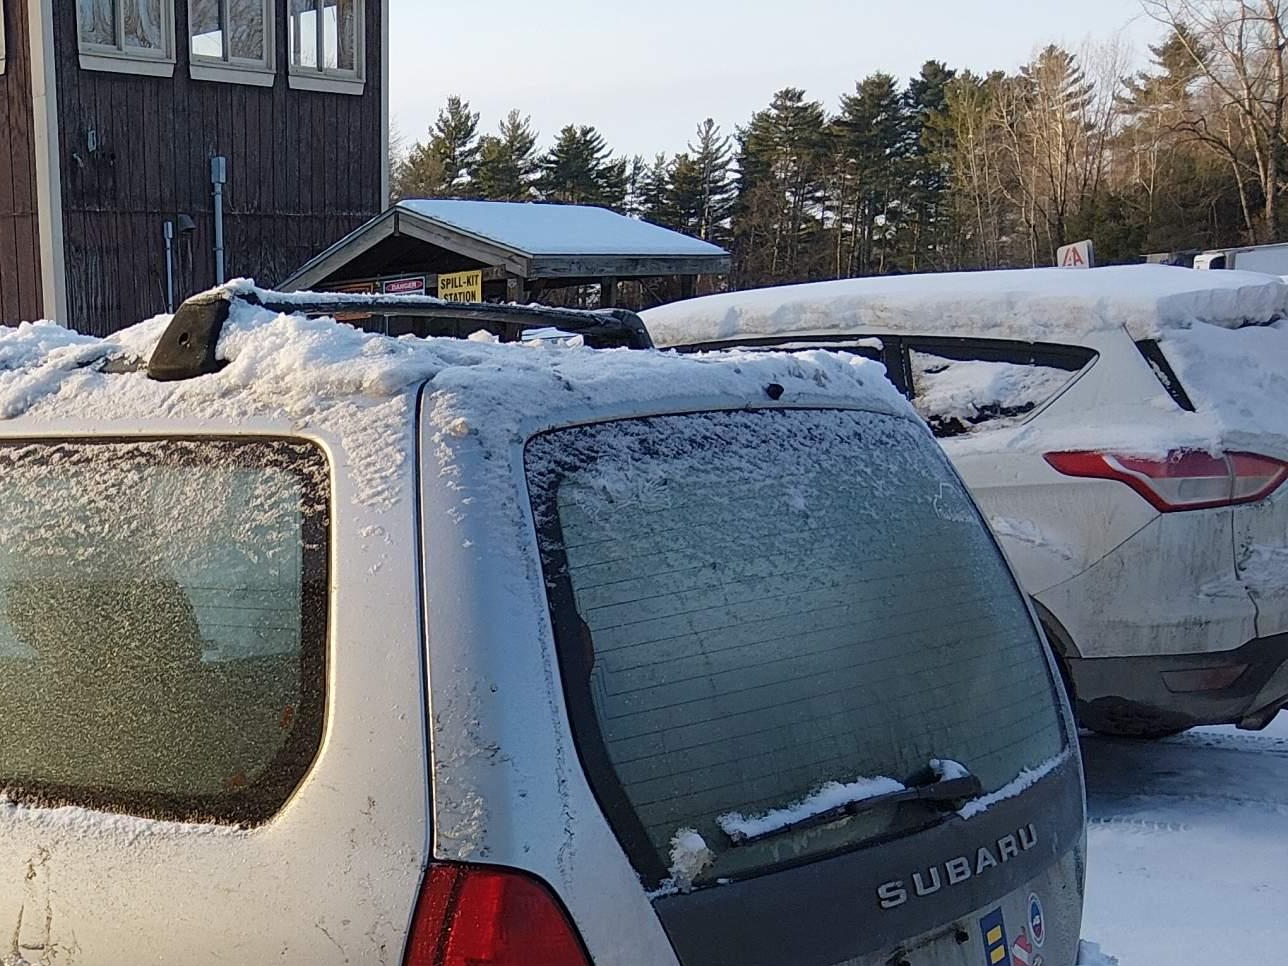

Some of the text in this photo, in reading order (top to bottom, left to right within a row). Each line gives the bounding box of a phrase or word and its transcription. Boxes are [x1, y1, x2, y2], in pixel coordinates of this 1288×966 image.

[440, 274, 479, 290] SPILL-KIT
[443, 290, 477, 303] STATION
[877, 823, 1039, 909] SUBARU
